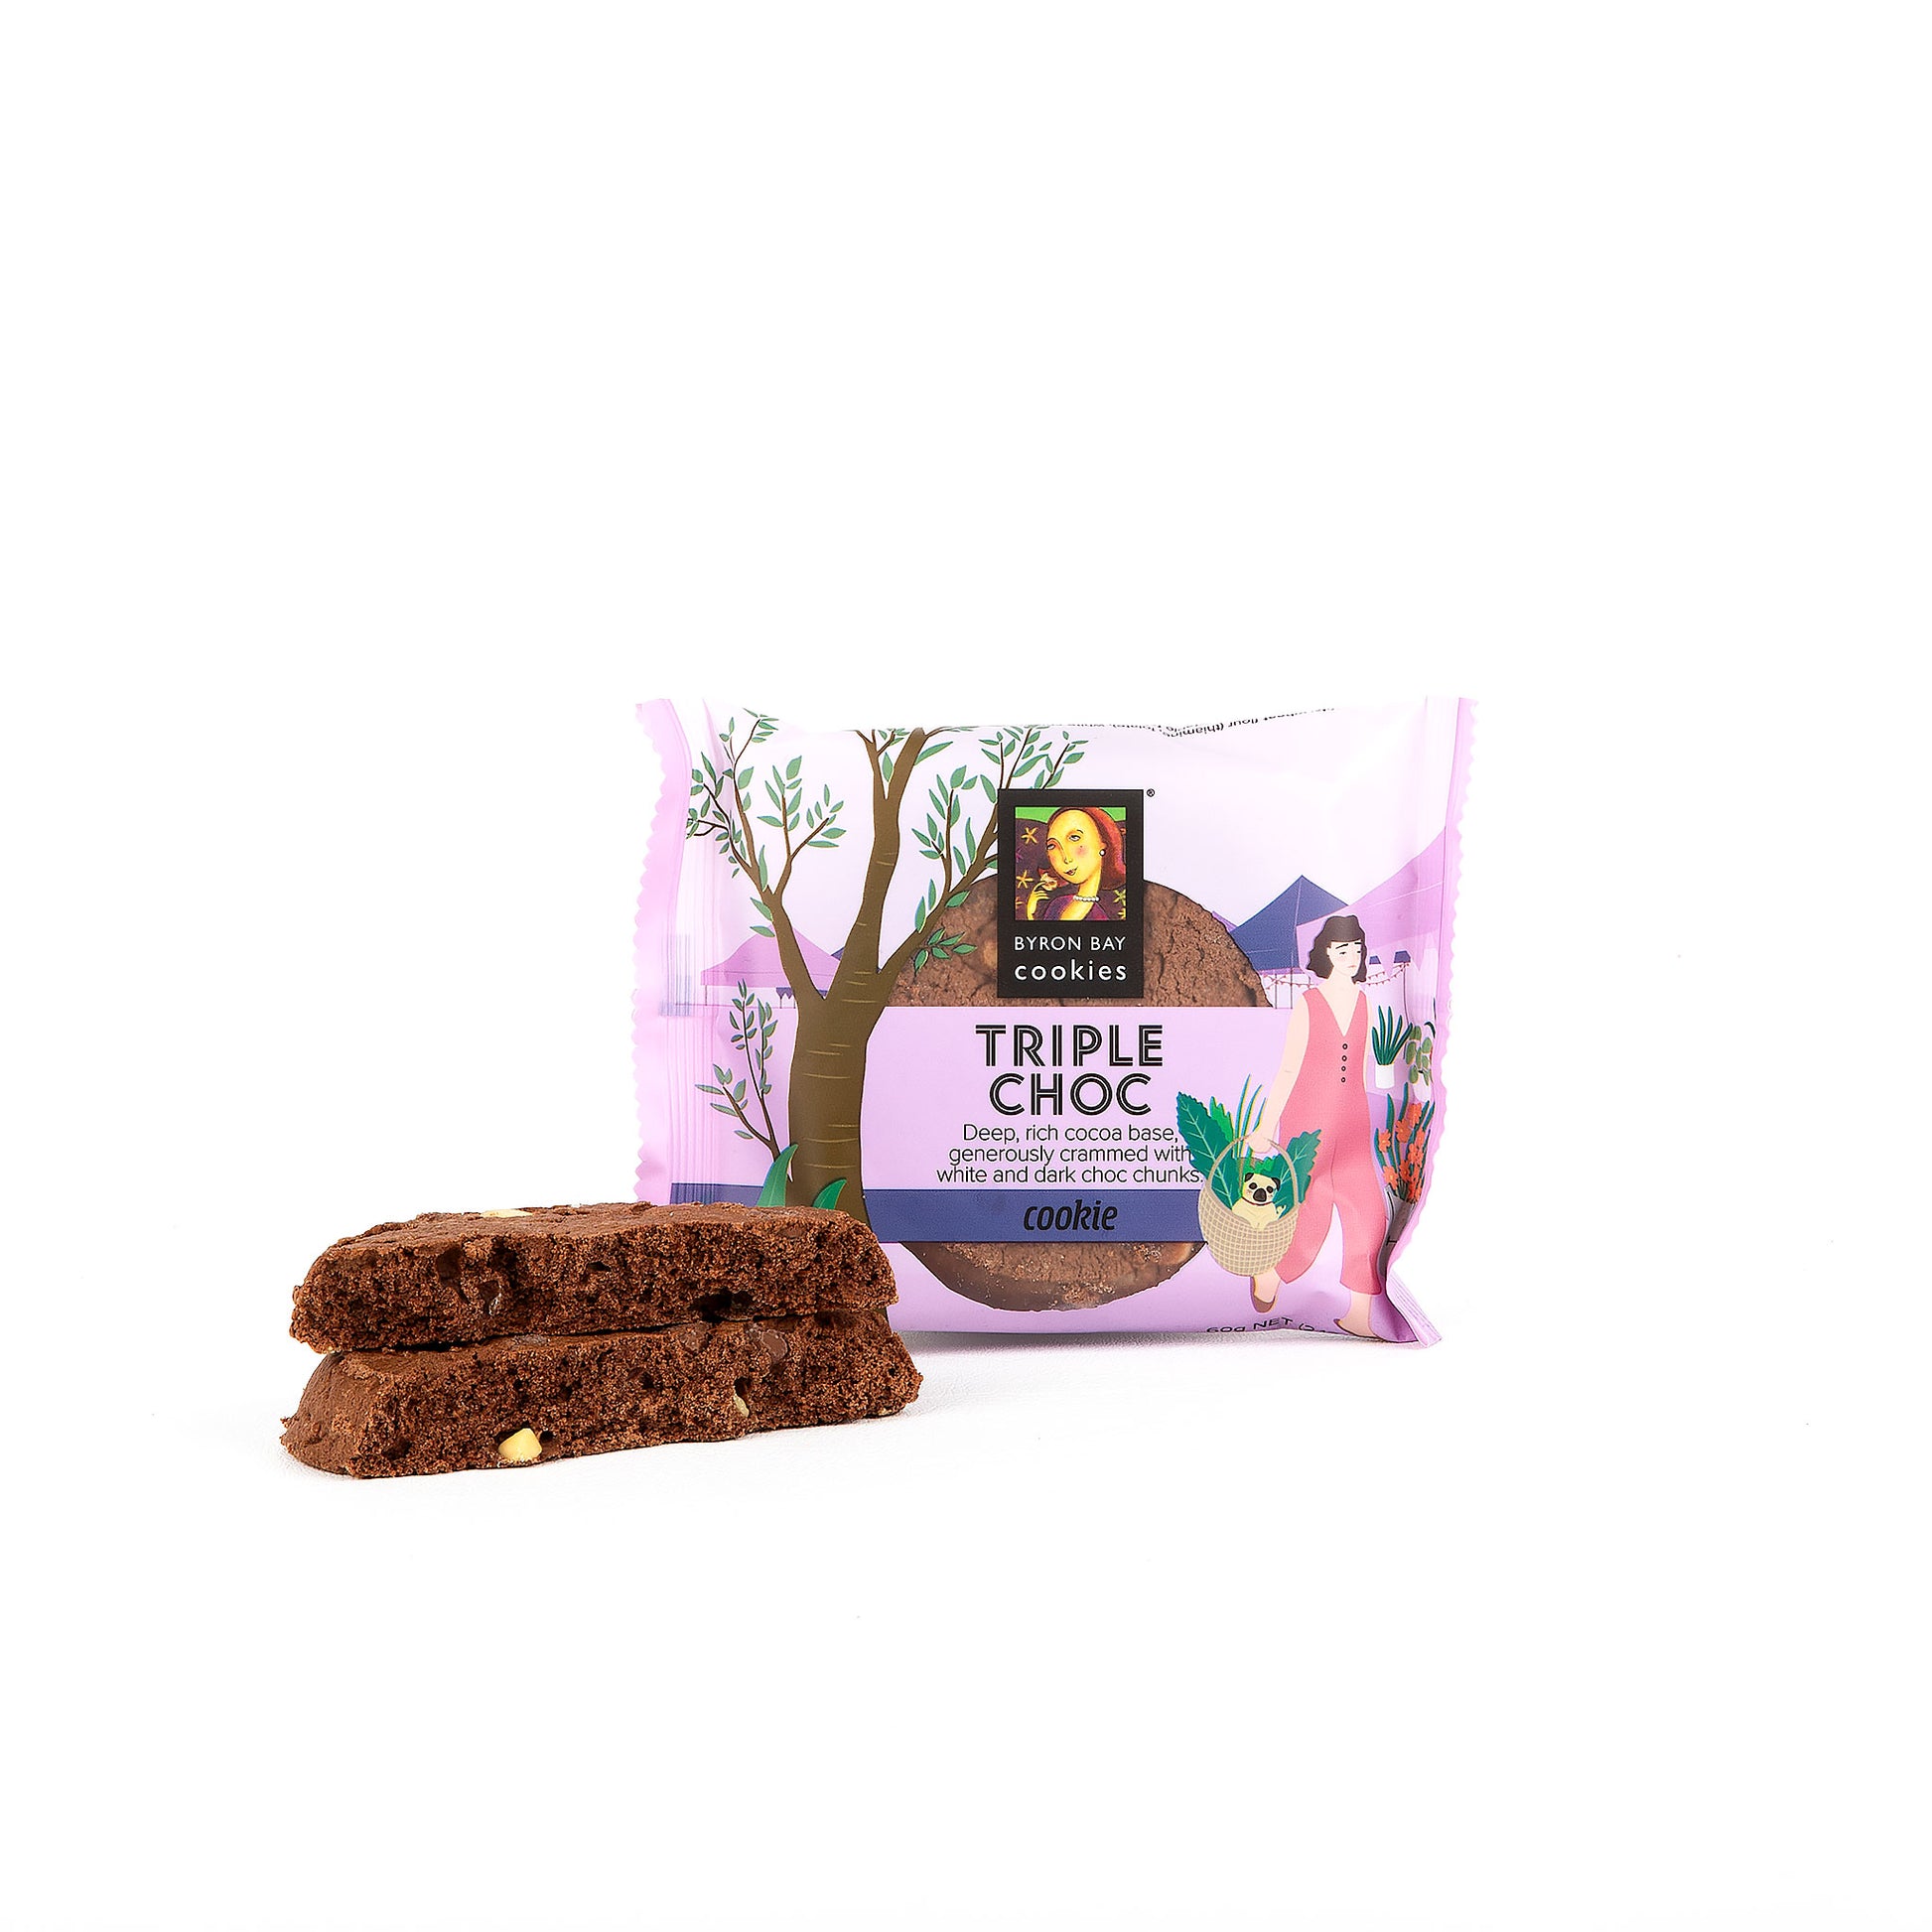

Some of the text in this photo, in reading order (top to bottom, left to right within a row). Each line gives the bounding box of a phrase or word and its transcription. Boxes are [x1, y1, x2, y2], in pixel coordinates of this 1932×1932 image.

[1014, 936, 1127, 952] BYRON BAY
[1014, 959, 1128, 982] cookies
[975, 1025, 1163, 1067] TRIPLE
[989, 1072, 1152, 1116] CHOC
[963, 1124, 1178, 1145] Deep, rich cocoa base,
[949, 1145, 1191, 1167] generously crammed with
[936, 1166, 1203, 1182] white and dark choc chunks.
[1023, 1199, 1118, 1231] cookie
[1253, 1317, 1293, 1330] NET
